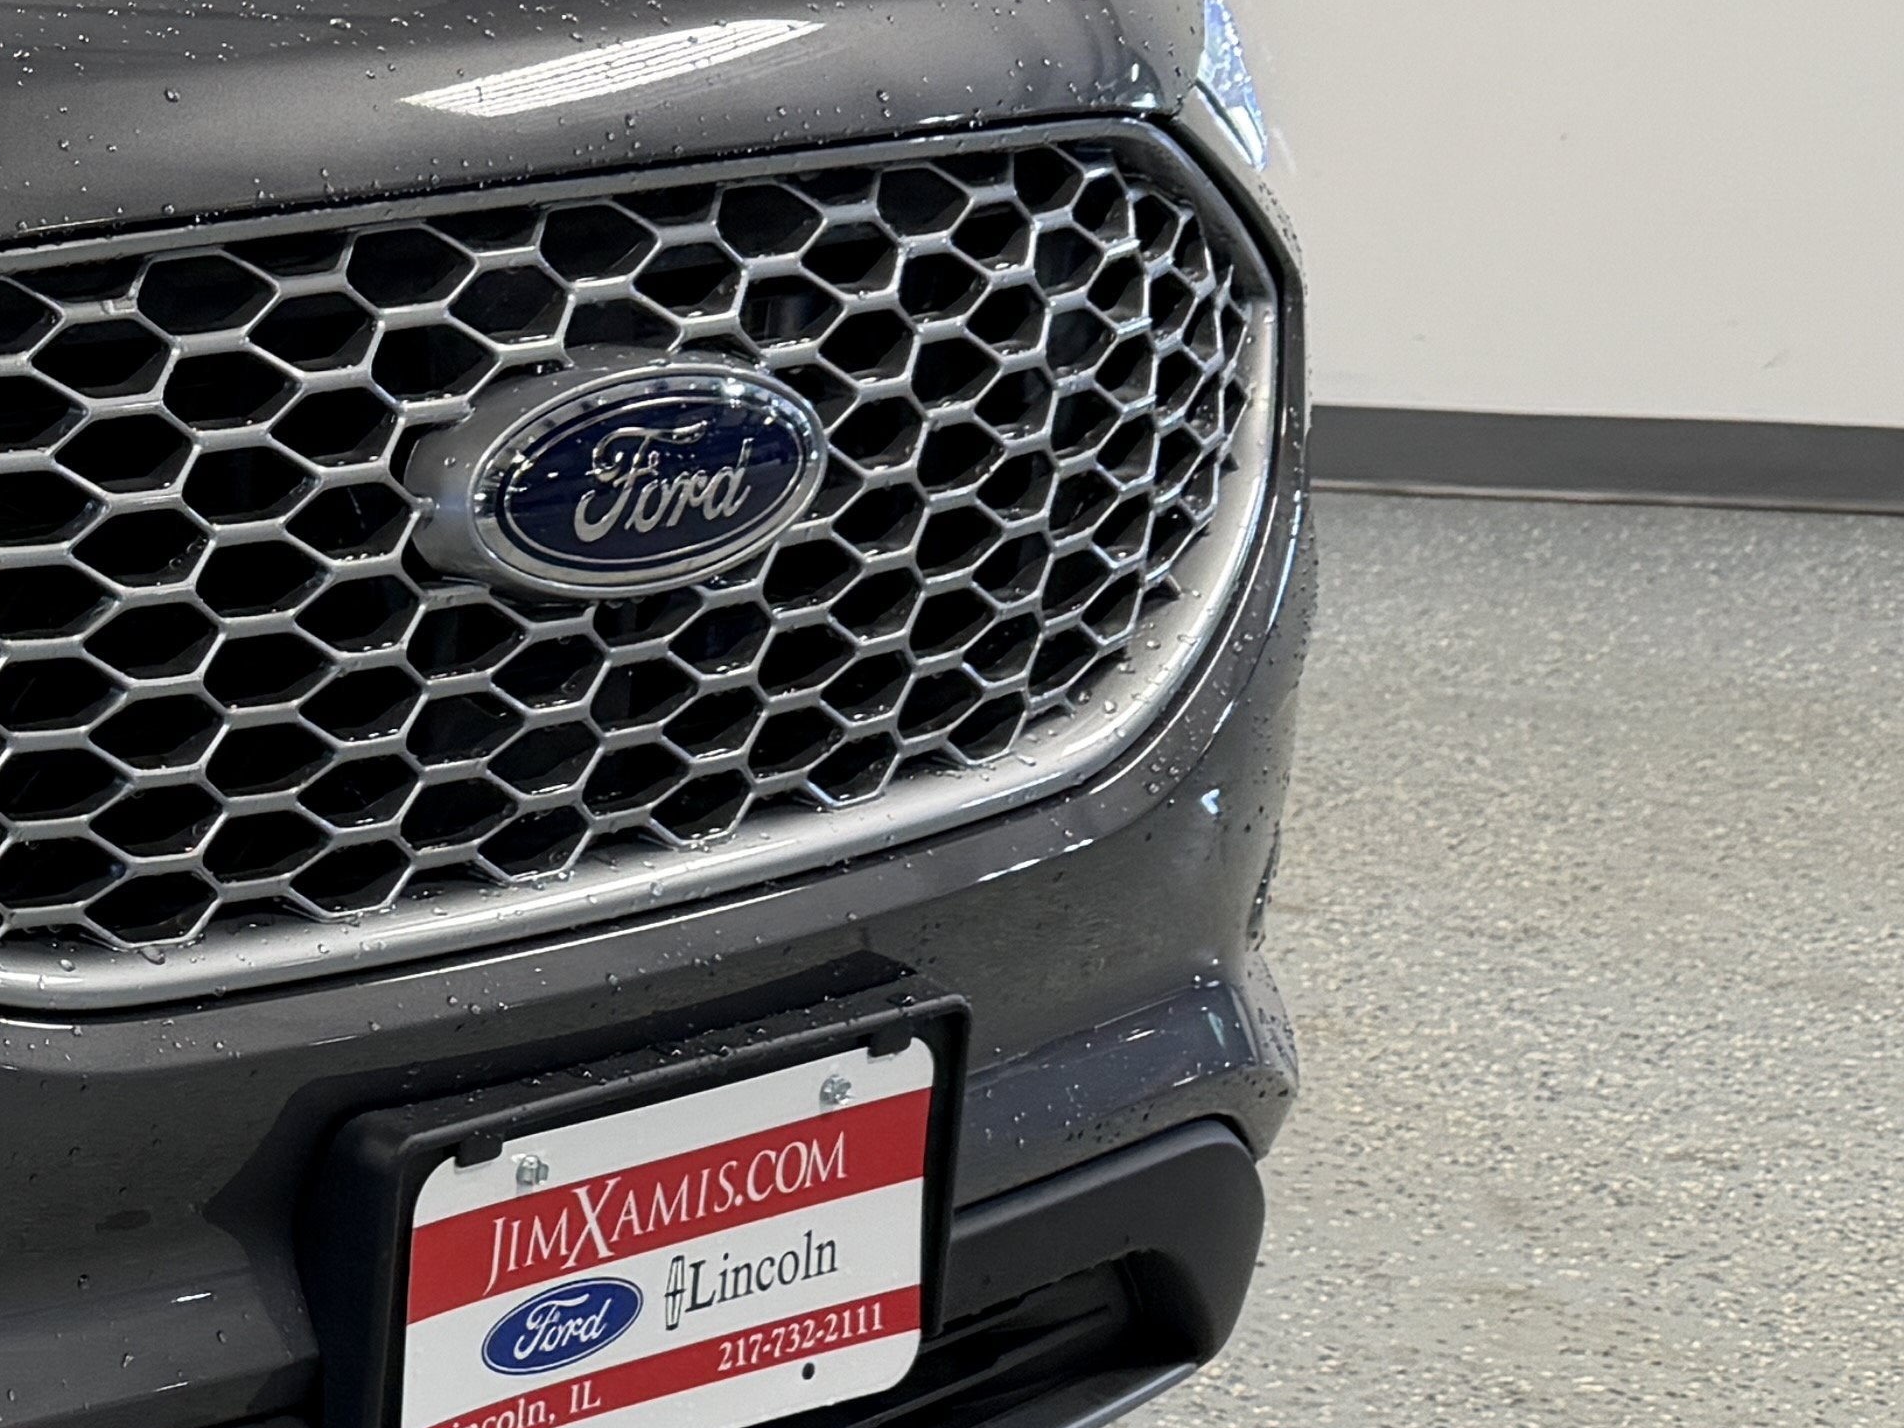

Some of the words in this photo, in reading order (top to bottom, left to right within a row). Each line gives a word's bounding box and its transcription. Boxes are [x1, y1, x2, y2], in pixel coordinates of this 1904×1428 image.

[574, 420, 754, 543] Ford
[685, 1229, 838, 1313] Lincoln
[513, 1293, 611, 1360] Ford
[718, 1302, 884, 1371] 217-732-2111
[569, 1380, 602, 1413] IL
